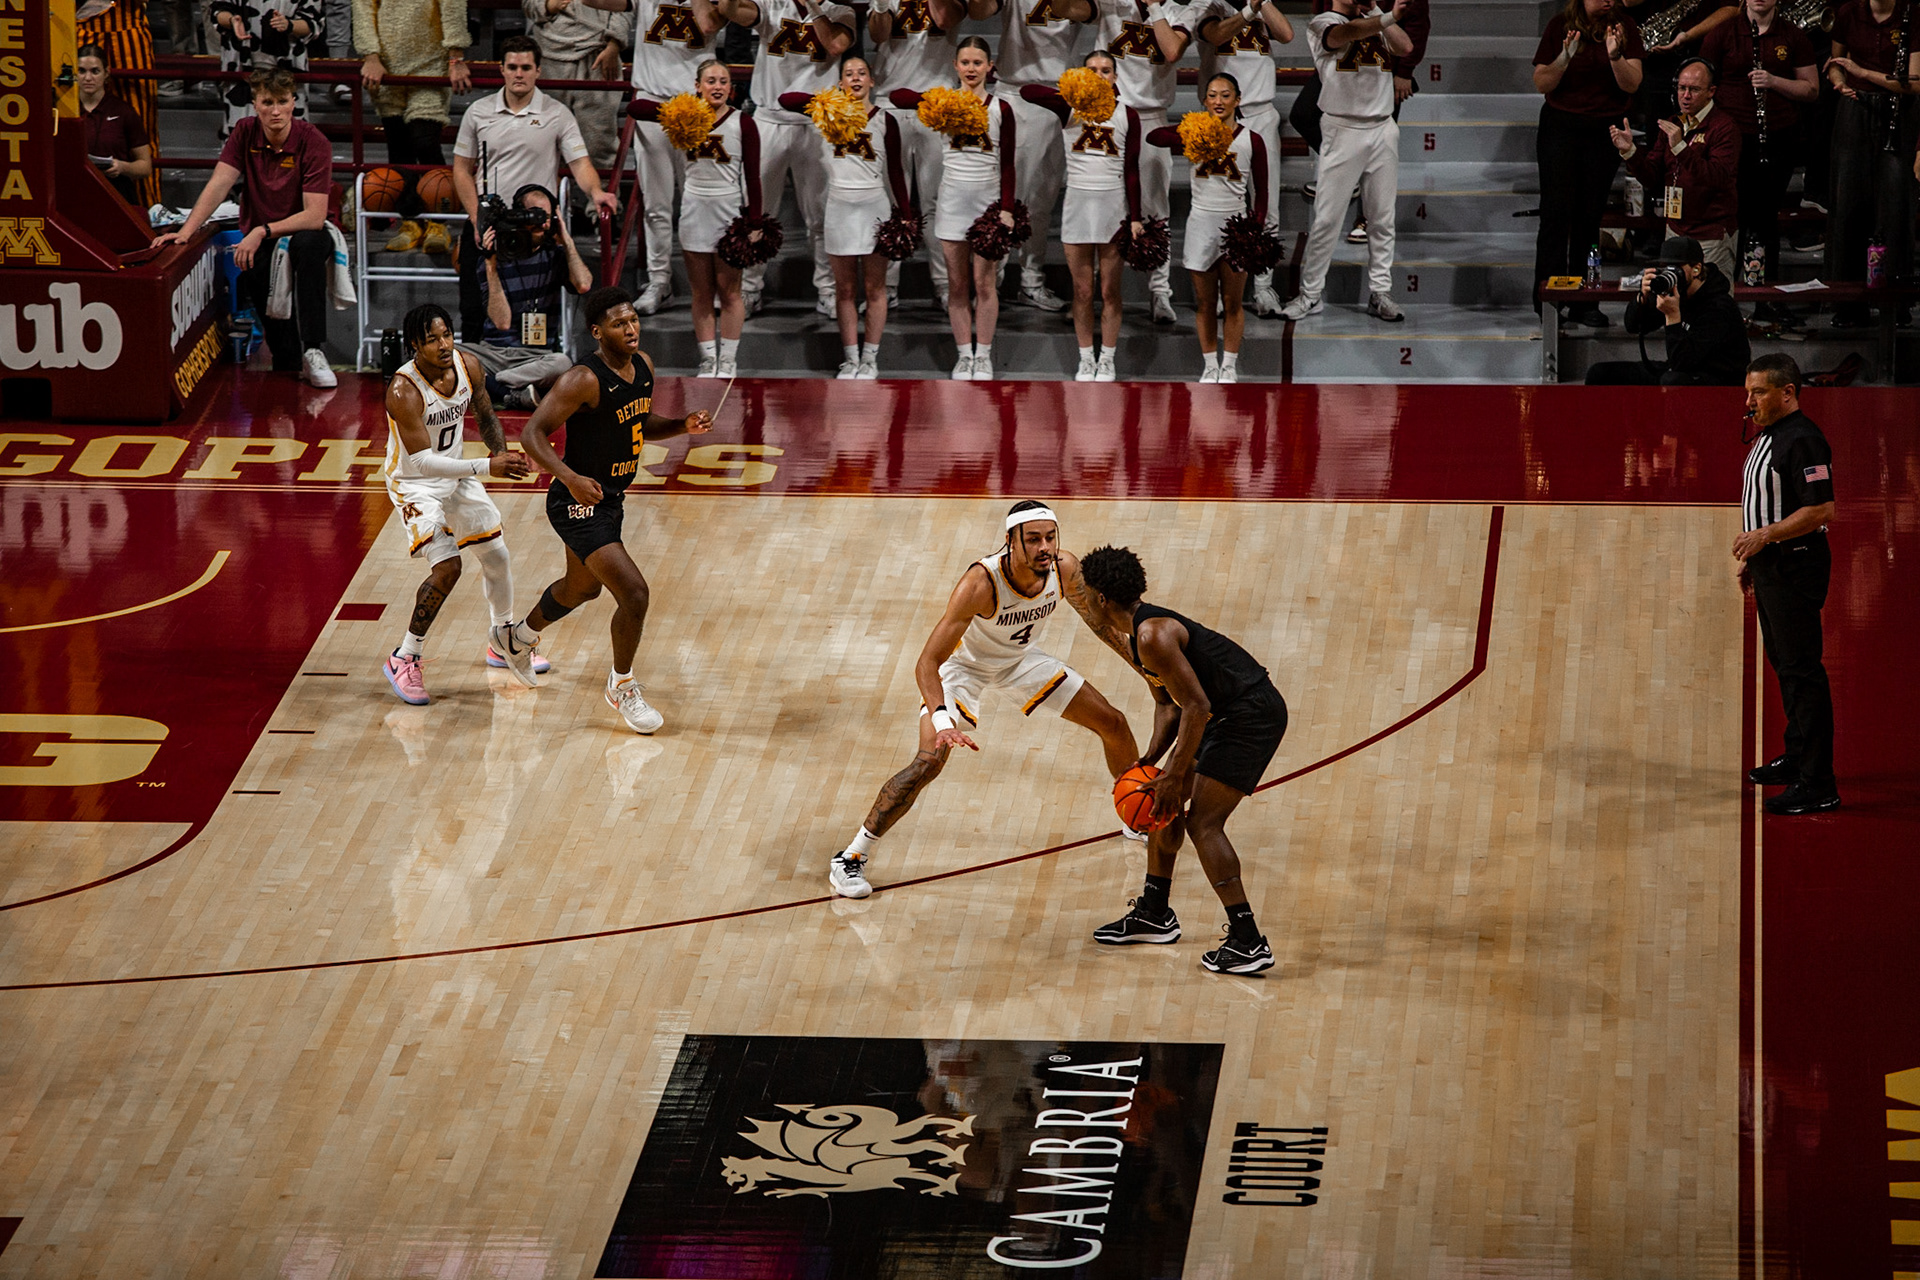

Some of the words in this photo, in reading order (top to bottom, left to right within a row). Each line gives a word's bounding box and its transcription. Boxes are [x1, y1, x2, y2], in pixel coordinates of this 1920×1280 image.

[1430, 64, 1441, 81] 6
[1072, 124, 1119, 156] M
[1424, 133, 1435, 150] 5
[1416, 203, 1427, 220] 4
[1407, 275, 1418, 292] 3
[170, 244, 217, 354] SUBWAY
[0, 282, 123, 370] ub
[1400, 347, 1411, 365] 2
[437, 424, 458, 452] 0
[631, 421, 644, 455] 5
[1009, 623, 1035, 645] 4
[1222, 1122, 1329, 1207] COURT
